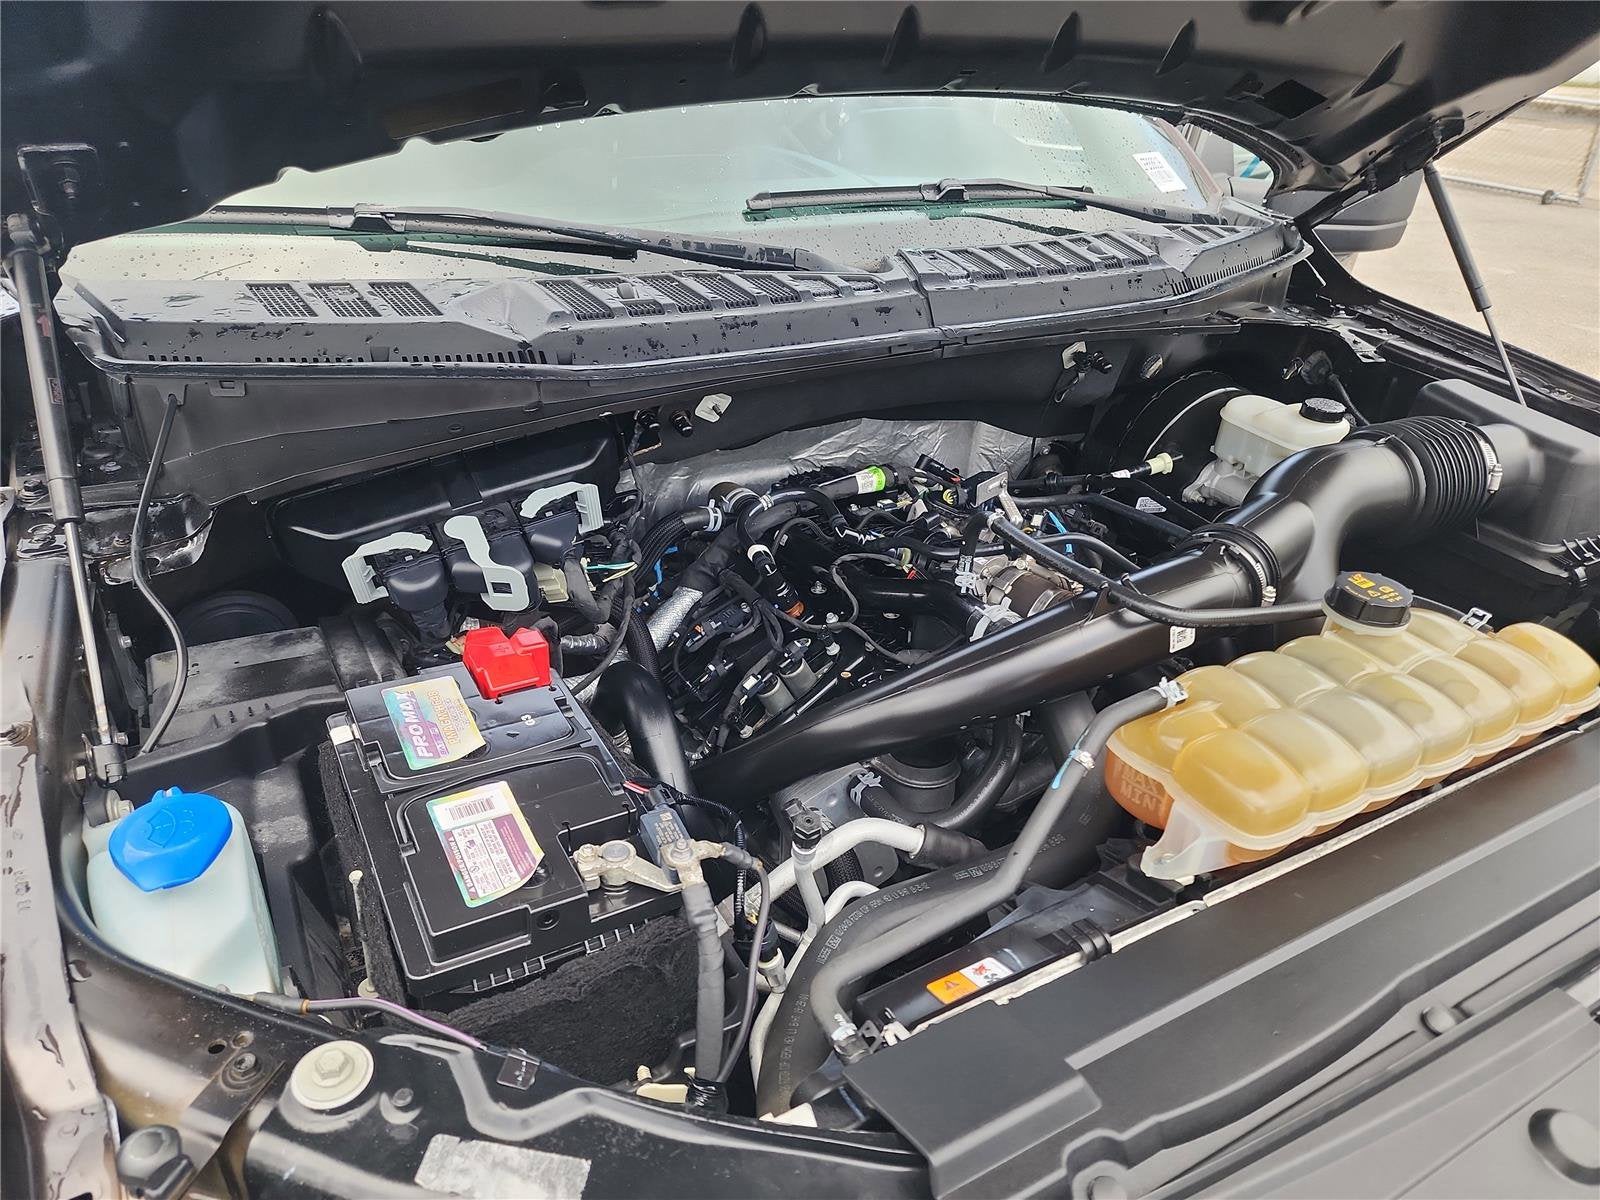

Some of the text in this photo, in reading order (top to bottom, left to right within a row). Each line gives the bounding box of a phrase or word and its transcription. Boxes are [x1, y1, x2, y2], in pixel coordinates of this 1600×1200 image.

[393, 689, 433, 758] PRO MAX
[1118, 780, 1157, 812] MIN
